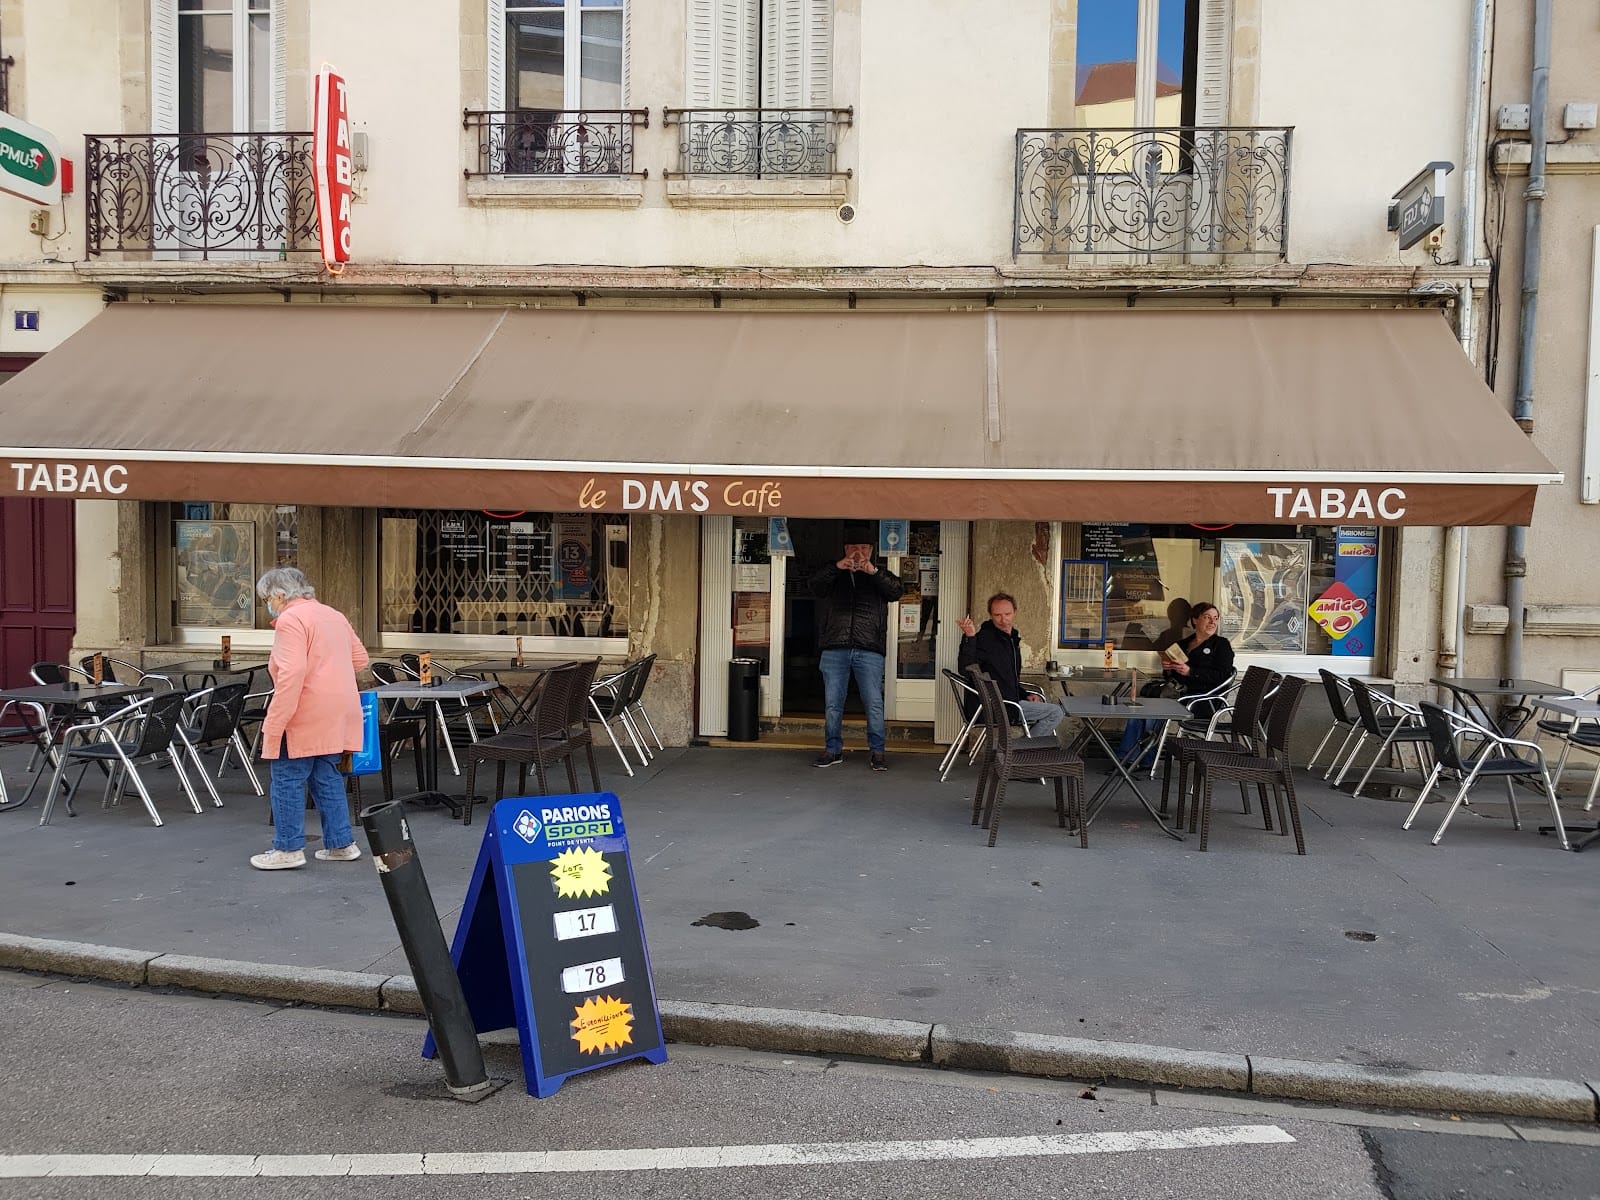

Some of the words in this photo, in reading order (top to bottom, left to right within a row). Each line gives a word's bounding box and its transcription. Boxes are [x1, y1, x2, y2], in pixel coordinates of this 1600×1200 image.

[0, 142, 29, 166] PMU
[336, 81, 351, 255] TABAC
[1403, 204, 1418, 229] FDJ
[22, 313, 29, 329] 1
[10, 463, 128, 494] TABAC
[578, 478, 607, 509] le
[622, 479, 710, 512] DM'S
[723, 481, 783, 513] Café
[1266, 487, 1407, 520] TABAC
[563, 546, 580, 560] 13
[541, 804, 611, 824] PARIONS
[548, 822, 610, 838] SPORT
[577, 912, 597, 932] 17
[584, 965, 606, 986] 78
